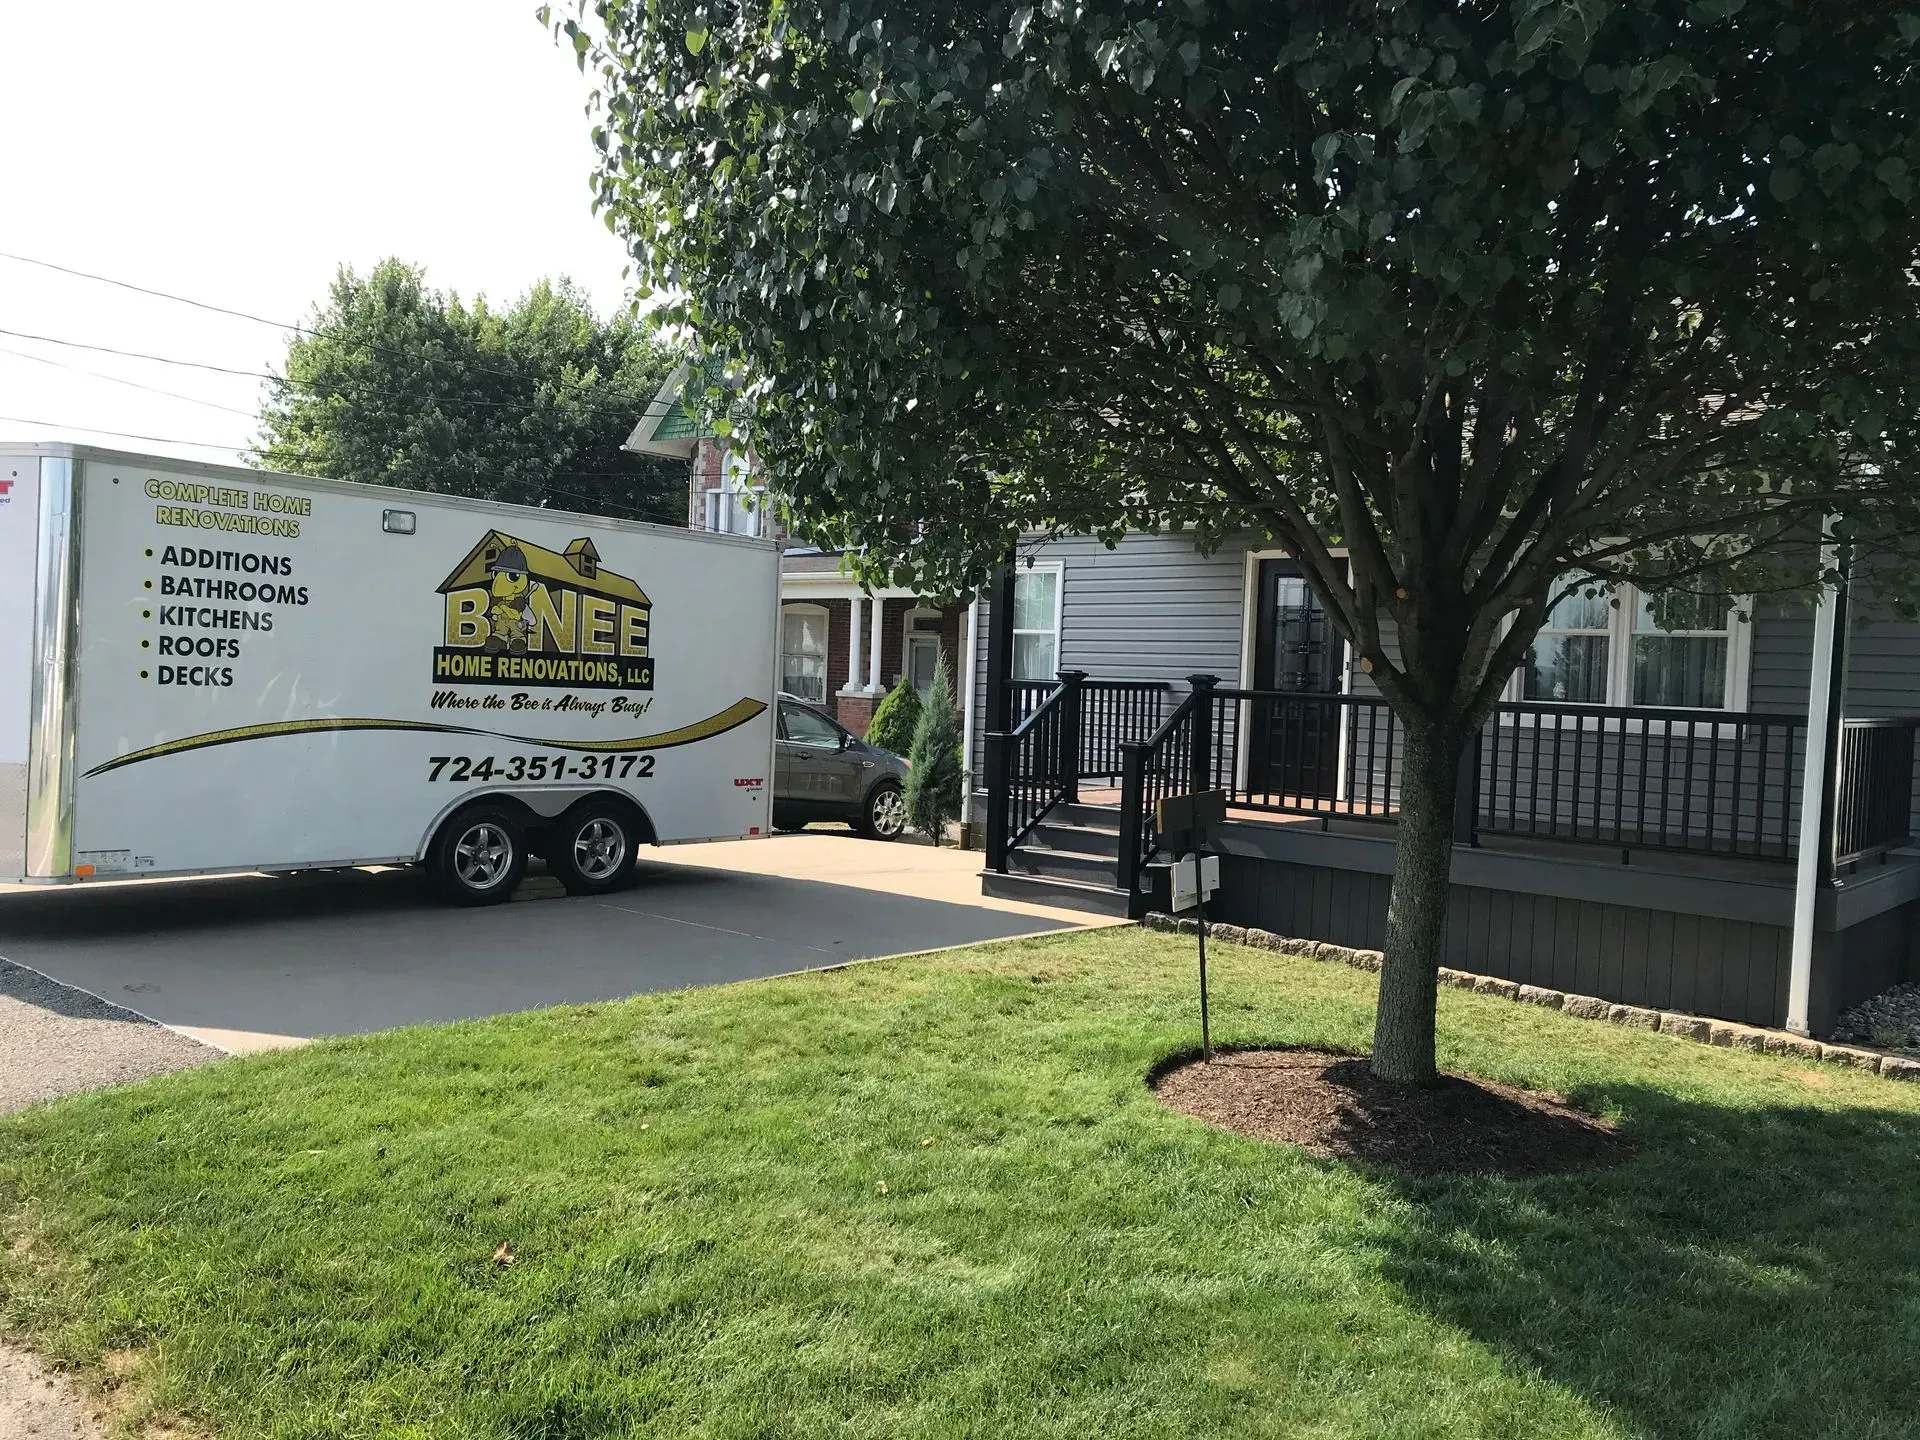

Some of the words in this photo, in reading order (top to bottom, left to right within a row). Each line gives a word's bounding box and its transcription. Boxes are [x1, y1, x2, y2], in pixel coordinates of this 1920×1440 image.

[144, 478, 248, 509] COMPLETE
[253, 492, 311, 515] HOME
[156, 505, 300, 538] RENOVATIONS
[160, 545, 292, 576] ADDITIONS
[160, 575, 309, 606] BATHROOMS
[159, 605, 273, 632] KITCHENS
[158, 635, 240, 658] ROOFS
[158, 665, 233, 687] DECKS
[437, 654, 491, 677] HOME
[497, 657, 623, 687] RENOVATIONS,
[627, 668, 650, 684] LLC
[430, 690, 479, 709] Where
[482, 693, 505, 709] the
[511, 692, 539, 711] Bee
[542, 696, 552, 711] is
[553, 694, 607, 718] Always
[611, 695, 652, 718] Busy!
[428, 755, 656, 782] 724-351-3172
